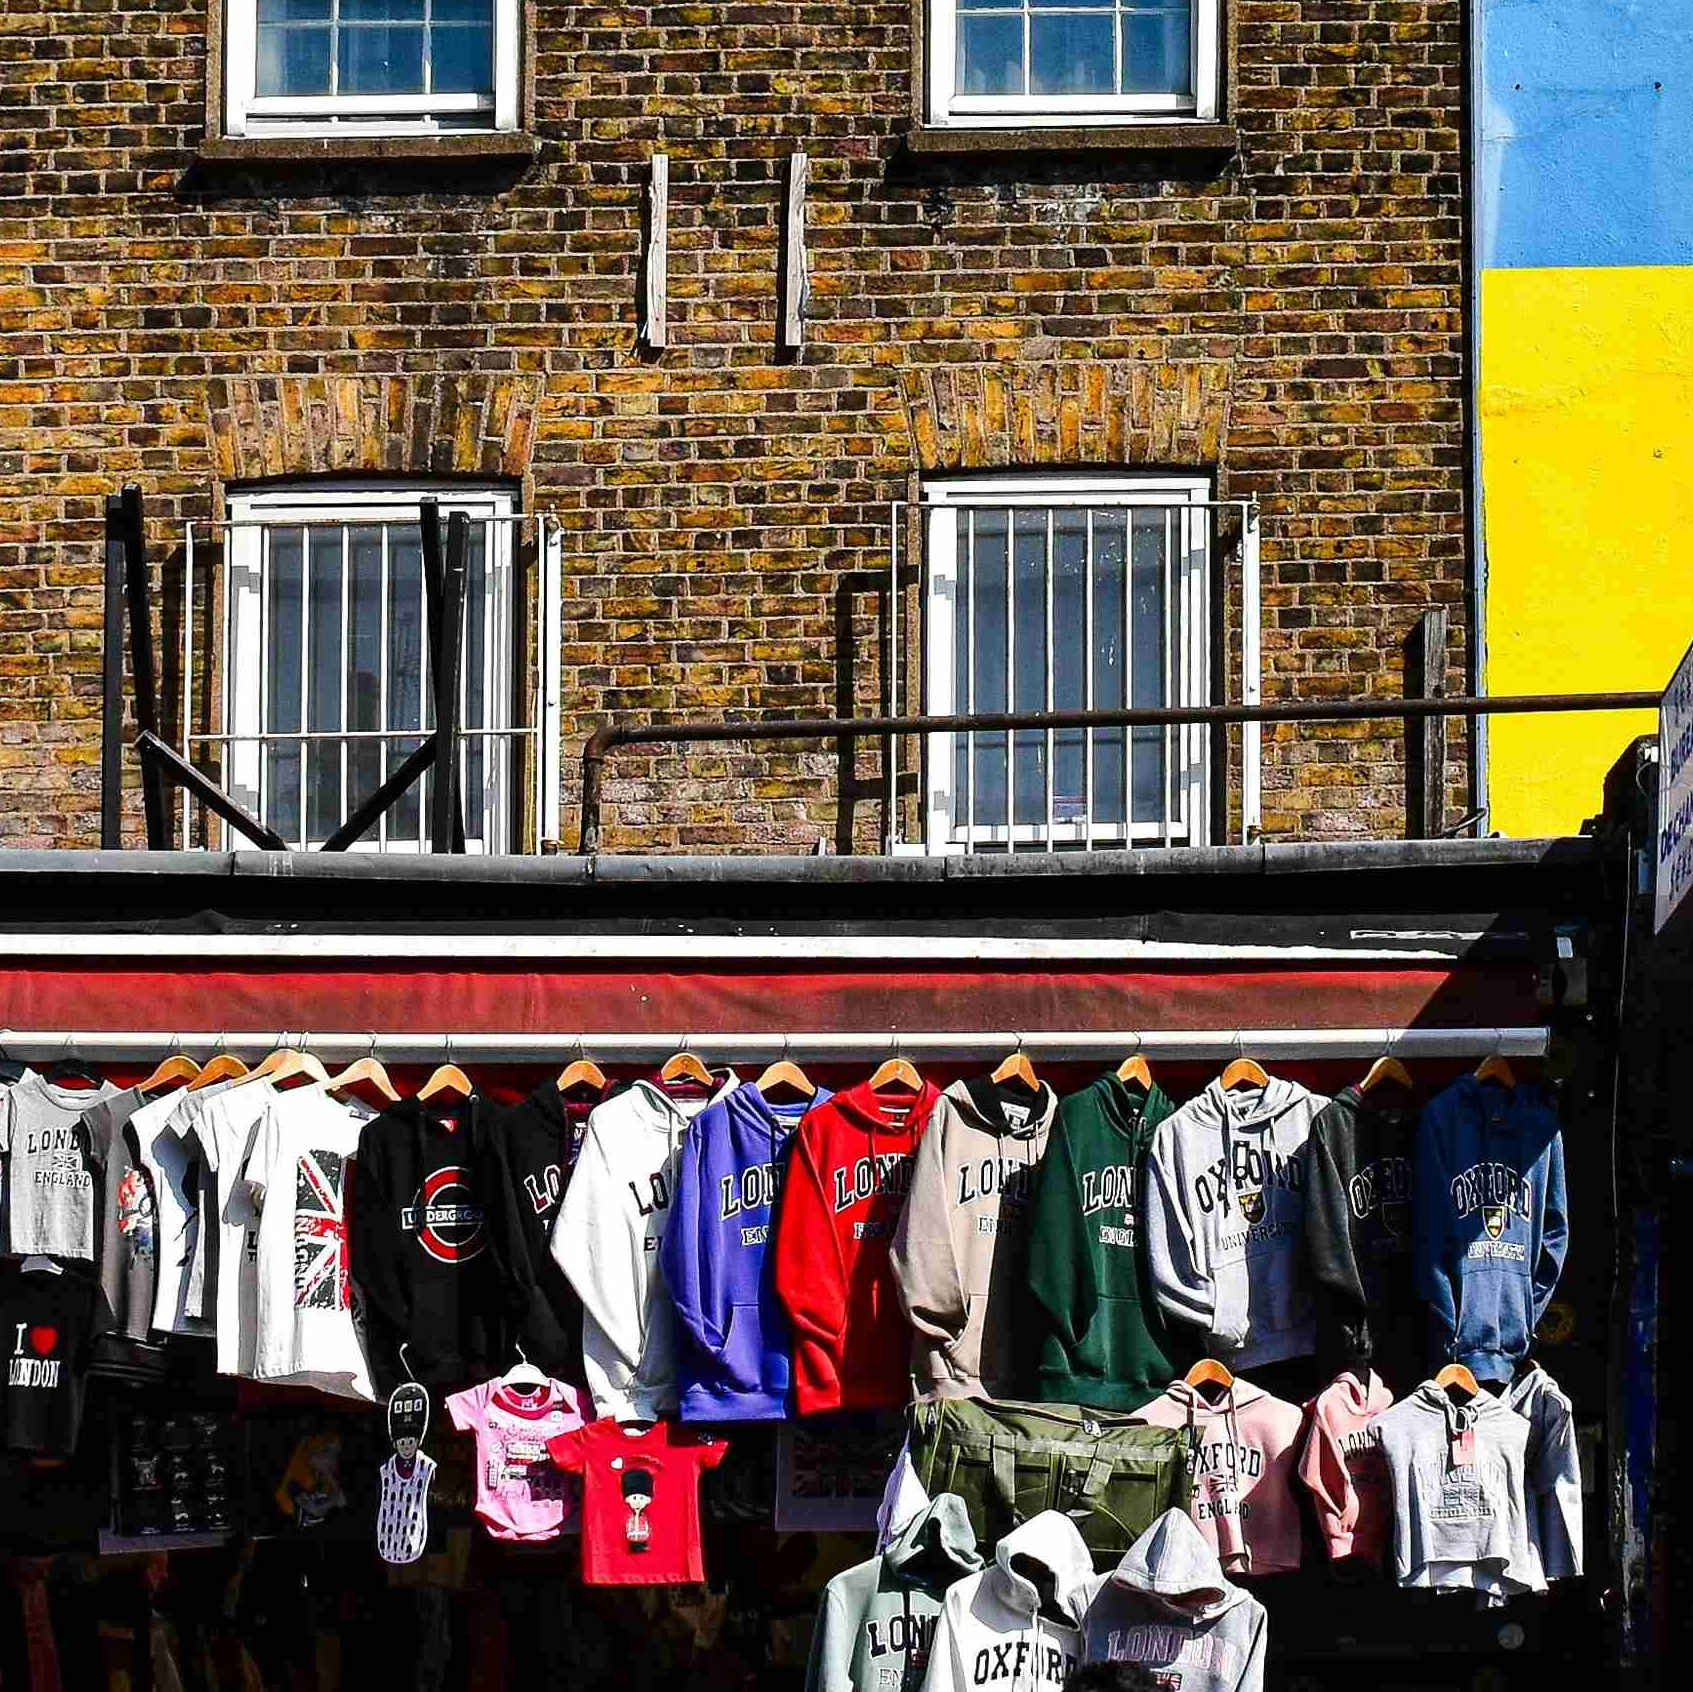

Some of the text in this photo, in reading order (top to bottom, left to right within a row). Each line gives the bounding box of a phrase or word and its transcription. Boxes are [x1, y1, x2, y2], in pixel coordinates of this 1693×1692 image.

[34, 1170, 93, 1188] ENGLAND
[1450, 1162, 1532, 1222] OXFORD
[14, 1323, 27, 1355] I
[8, 1358, 61, 1388] LONDON
